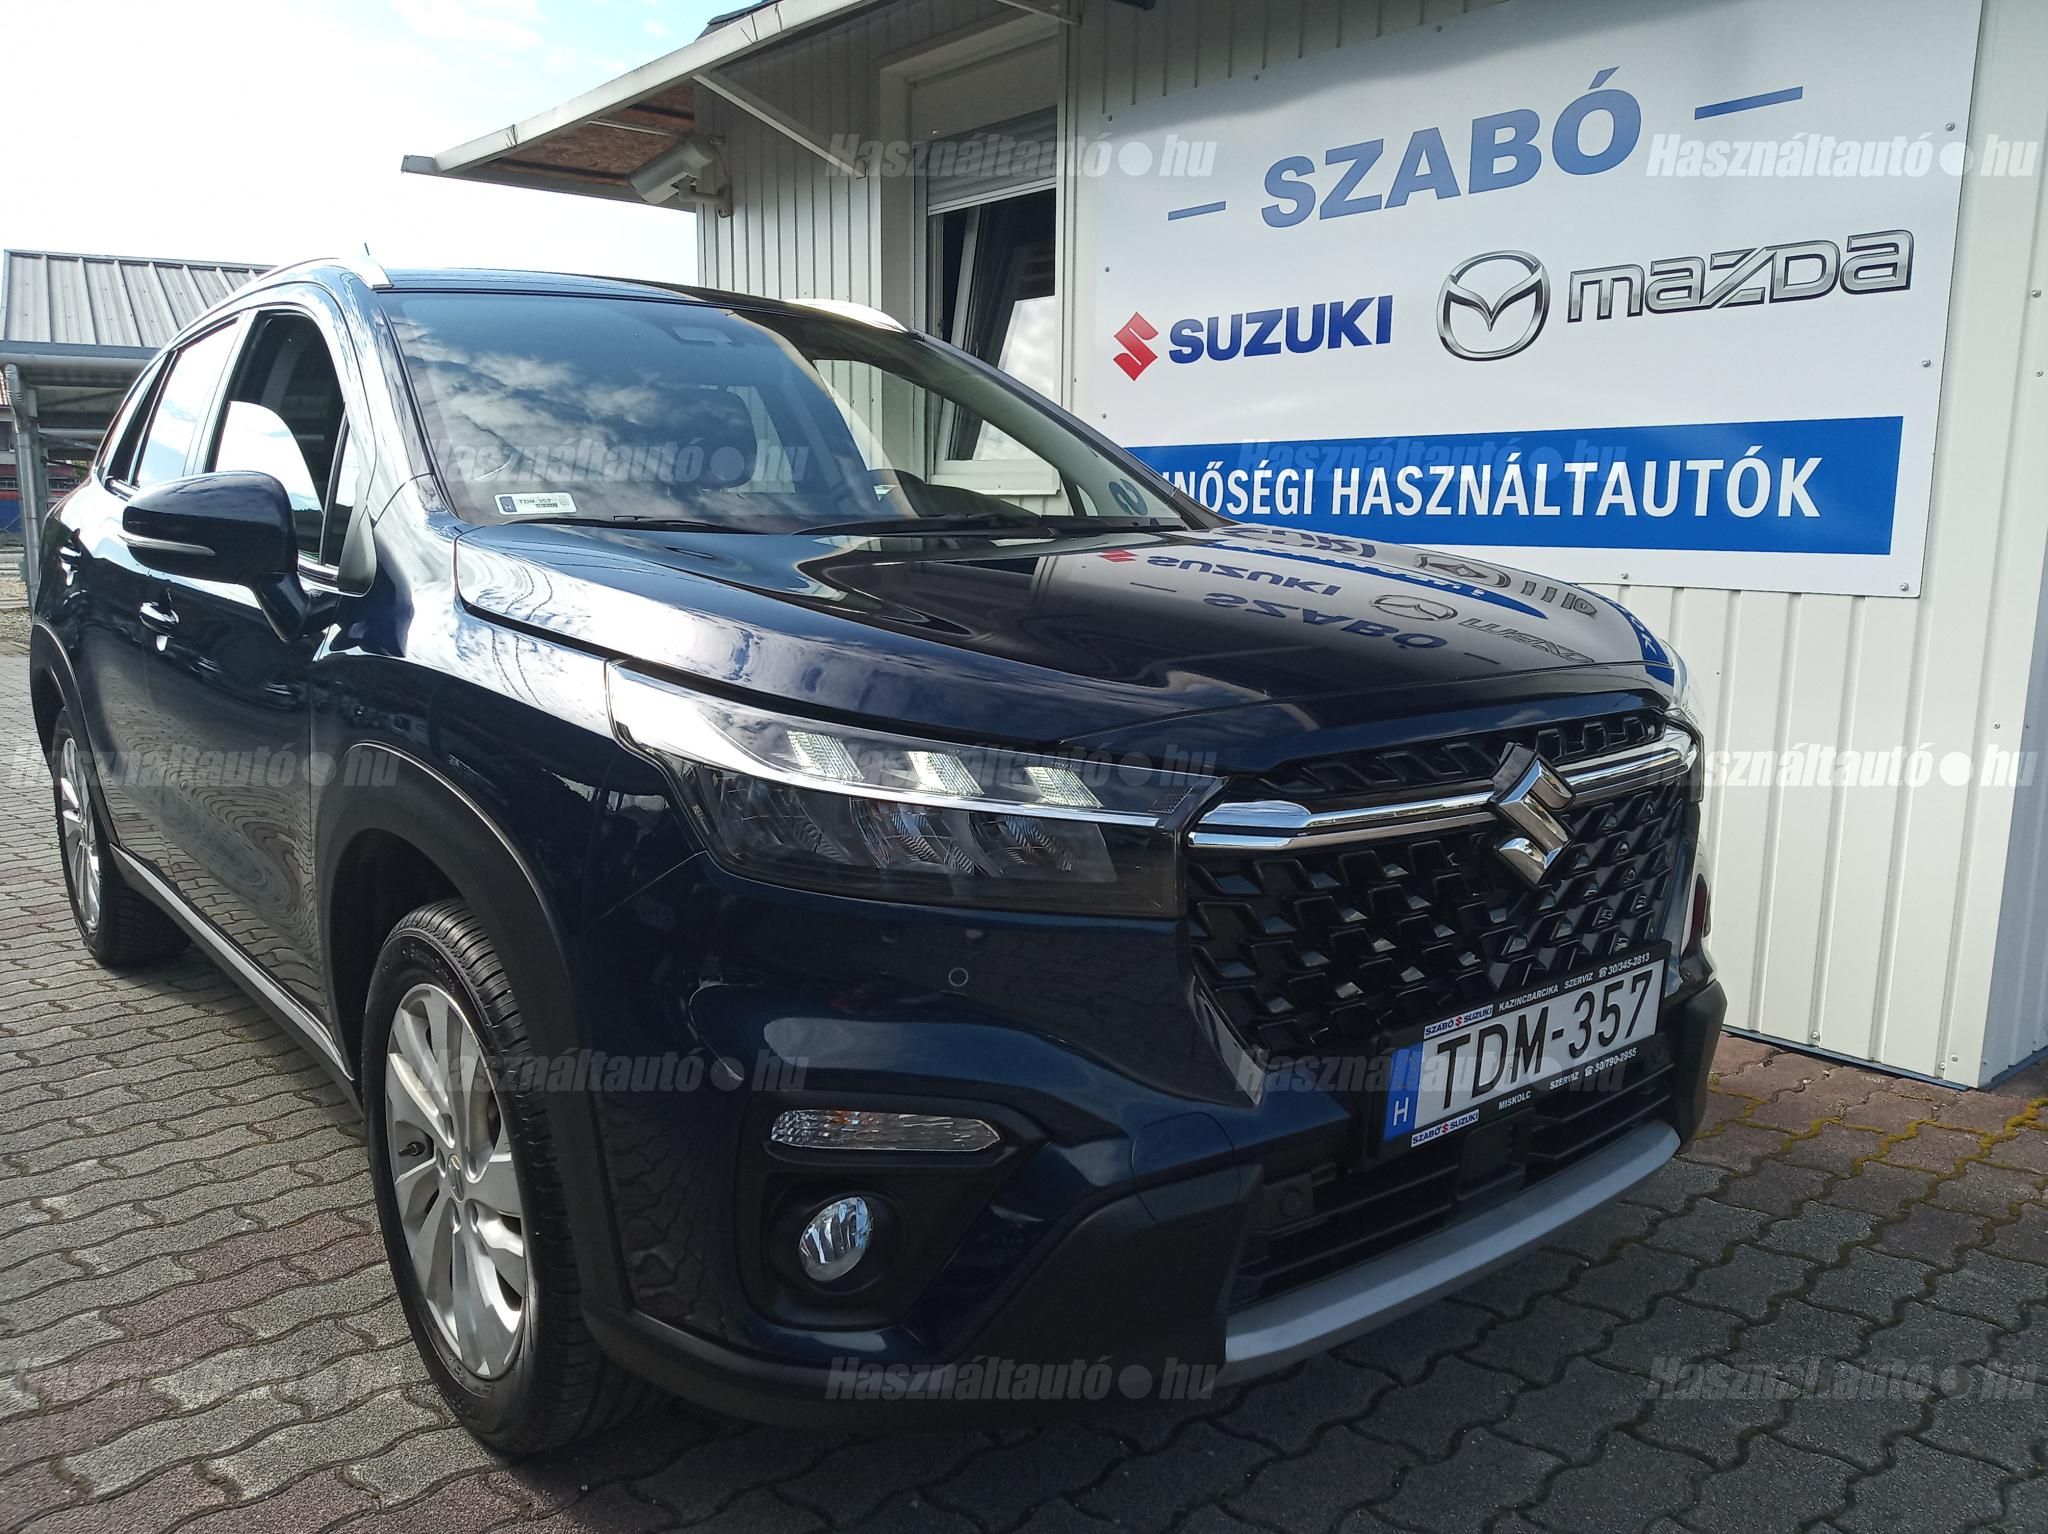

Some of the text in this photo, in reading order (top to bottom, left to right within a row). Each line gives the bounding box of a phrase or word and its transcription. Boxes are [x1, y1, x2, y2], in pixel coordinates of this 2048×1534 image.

[1261, 66, 1641, 228] SZABÓ
[1168, 295, 1393, 364] SUZUKI
[1162, 445, 1822, 518] NŐSÉGI HASZNÁLTAUTÓK
[1564, 972, 1593, 990] SZERVIZ
[1425, 1008, 1492, 1035] SZABÓ SUZUKI
[1437, 969, 1653, 1110] TDM-357
[1498, 1090, 1531, 1110] MISKOLC
[1550, 1072, 1579, 1090] SZERVIZ
[1393, 1096, 1409, 1126] H
[1412, 1112, 1478, 1145] SZABÓ SUZUKI
